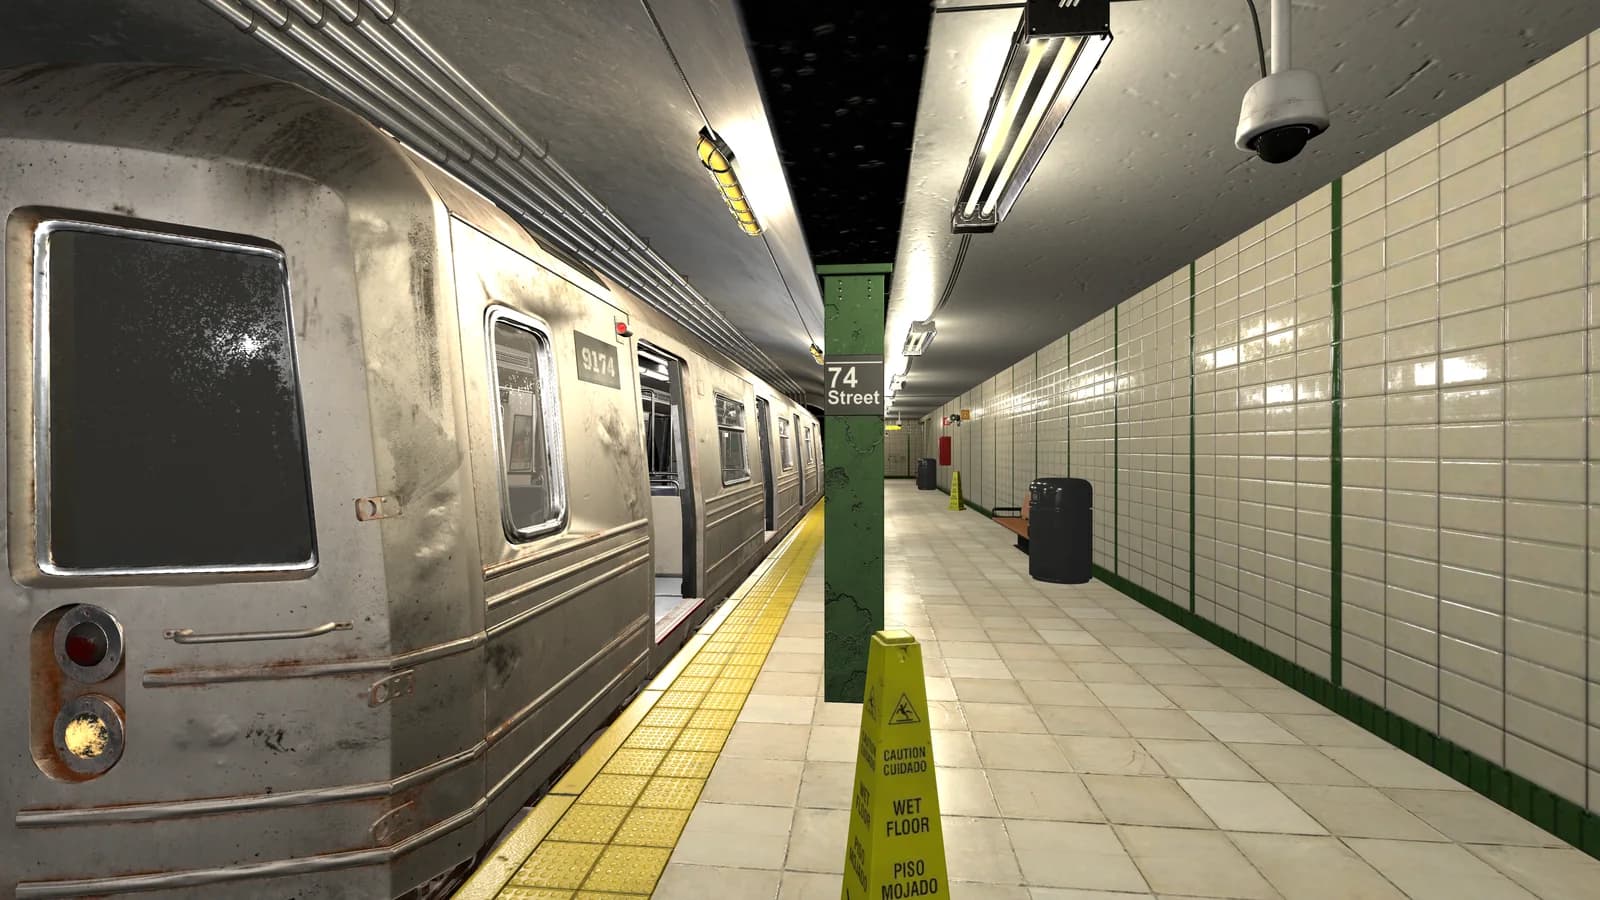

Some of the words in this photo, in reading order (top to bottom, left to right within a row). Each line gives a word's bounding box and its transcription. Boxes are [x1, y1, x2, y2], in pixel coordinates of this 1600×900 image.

[582, 346, 615, 377] 9174
[828, 366, 858, 388] 74
[828, 390, 880, 405] Street
[883, 746, 926, 761] CAUTION
[883, 760, 927, 776] CUIDADO
[893, 797, 922, 816] WET
[887, 817, 929, 837] FLOOR
[894, 859, 925, 879] PISO
[881, 878, 938, 900] MOJADO
